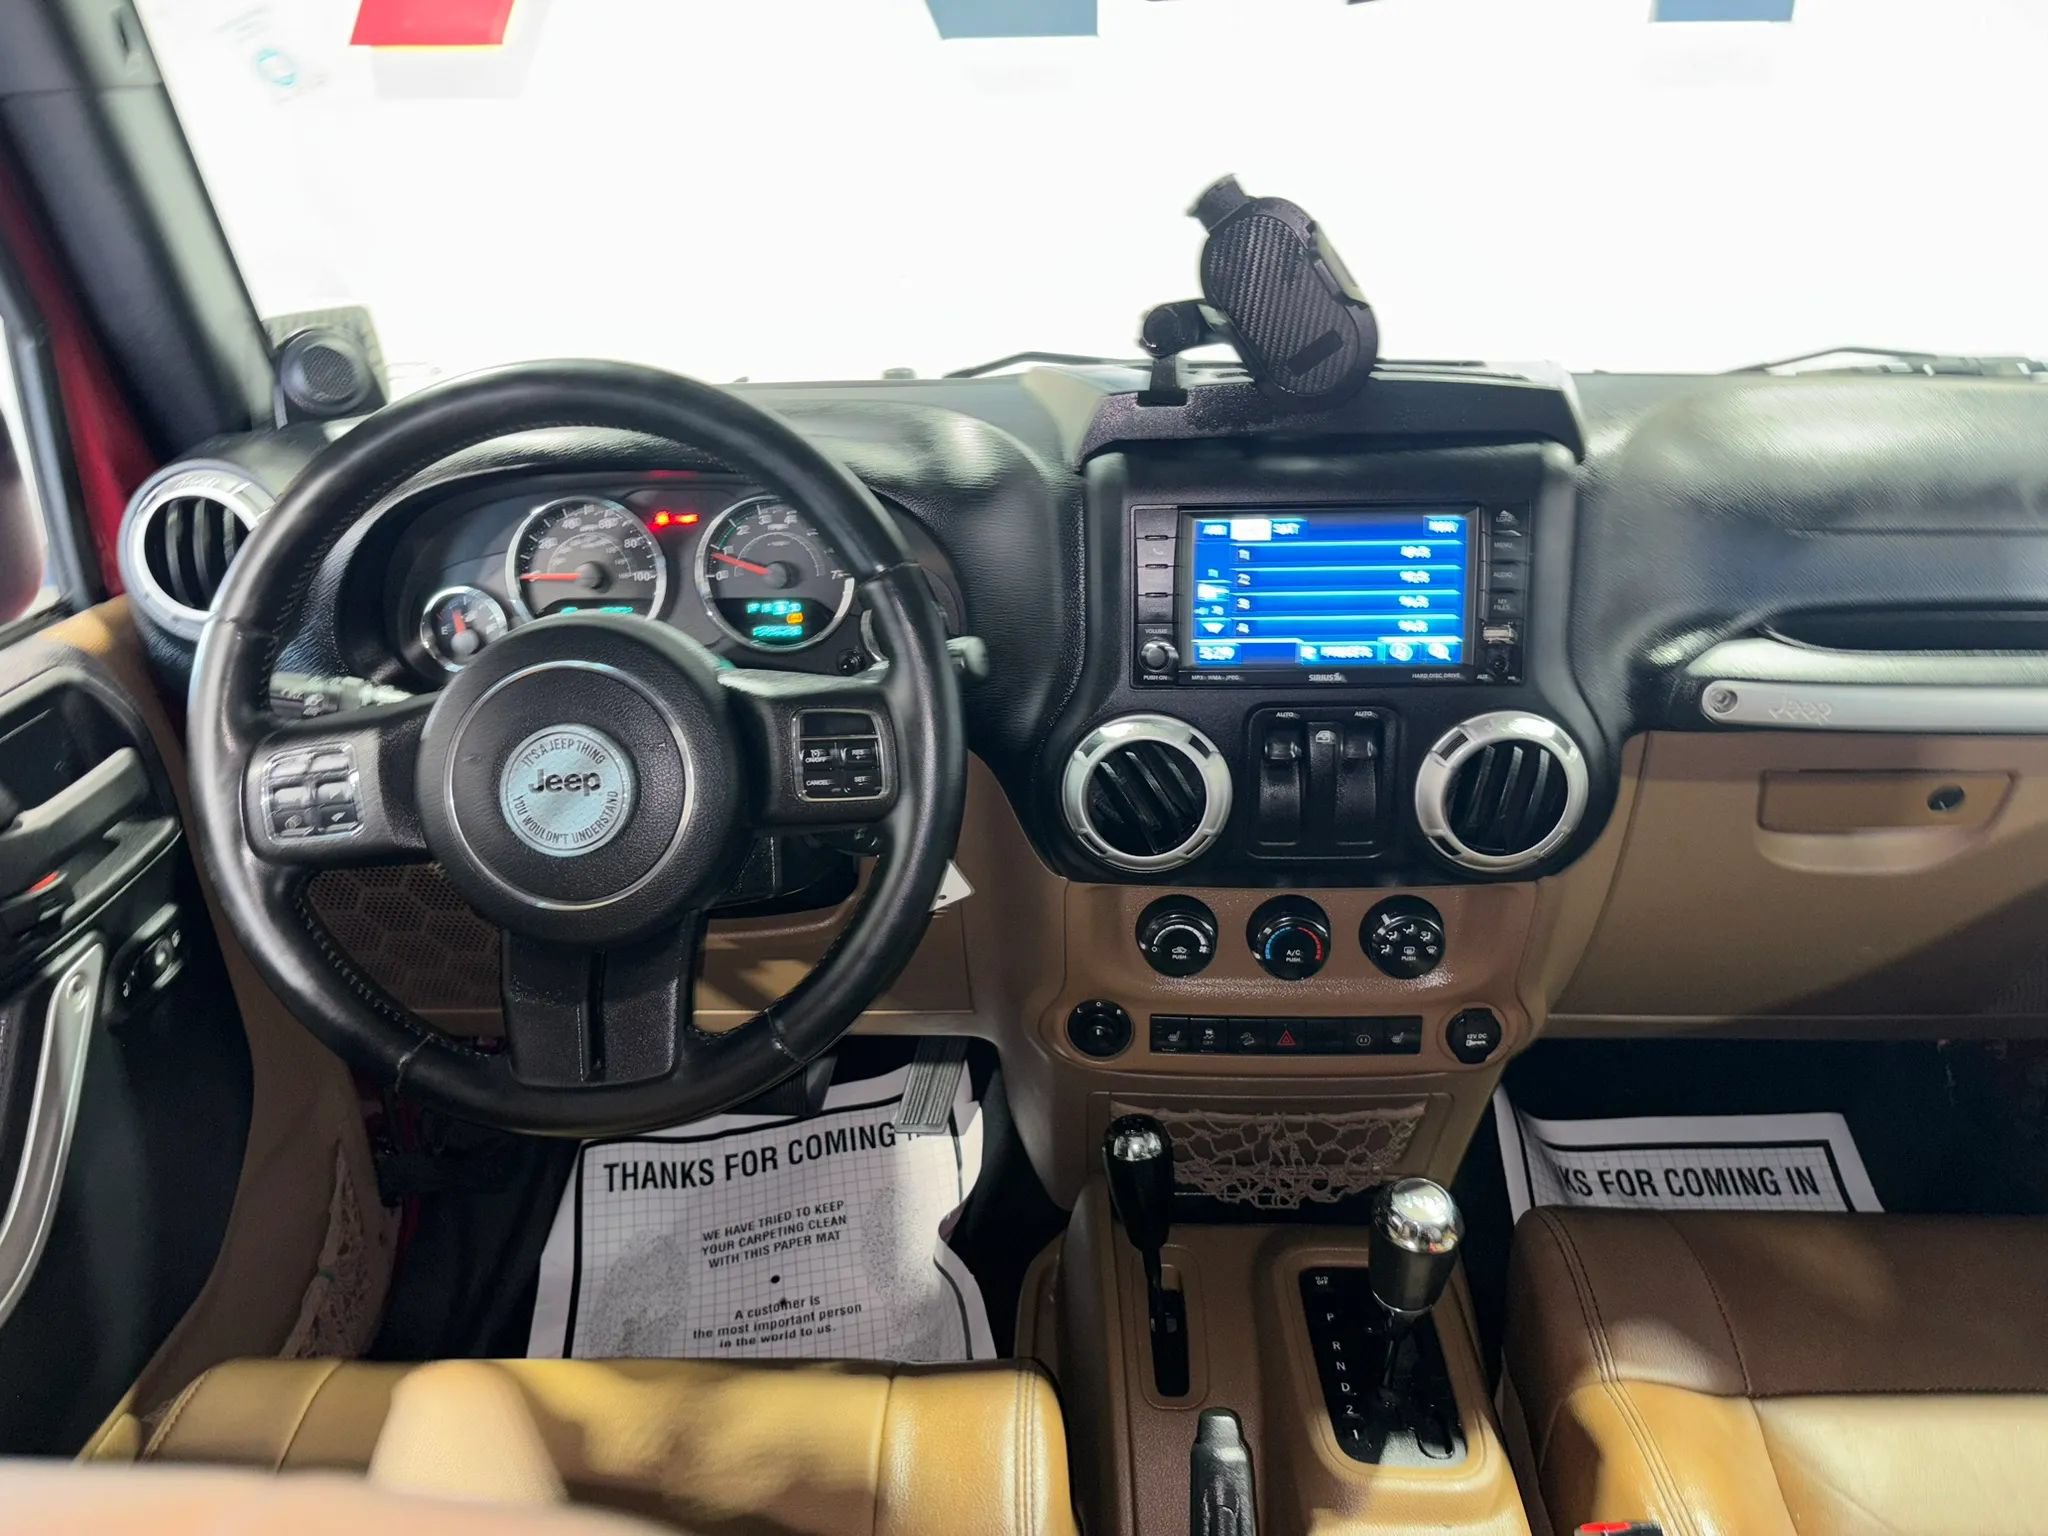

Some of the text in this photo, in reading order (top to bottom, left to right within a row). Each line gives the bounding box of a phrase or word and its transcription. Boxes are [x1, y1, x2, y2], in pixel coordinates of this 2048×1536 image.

[624, 538, 638, 548] 80
[736, 525, 749, 536] 2
[632, 571, 650, 582] 100
[549, 738, 575, 751] JEEP
[575, 739, 606, 765] THING
[528, 769, 601, 797] Jeep
[571, 790, 619, 844] UNDERSTAND
[603, 1121, 896, 1192] THANKS FOR COMING
[1598, 1168, 1660, 1197] FOR
[1664, 1167, 1779, 1197] COMING
[1785, 1166, 1821, 1197] IN
[702, 1200, 845, 1242] WE HAVE TRIED TO KEEP
[702, 1214, 847, 1256] YOUR CARPETING CLEAN
[708, 1230, 842, 1269] WITH THIS PAPER MAT
[734, 1295, 821, 1321] A customer is
[1326, 1312, 1335, 1321] P
[692, 1303, 862, 1340] the most important person
[719, 1339, 732, 1349] in
[736, 1336, 757, 1347] the
[760, 1328, 797, 1344] world
[800, 1326, 813, 1337] to
[1332, 1341, 1341, 1350] R
[1336, 1361, 1346, 1371] N
[1341, 1383, 1350, 1392] D
[1346, 1405, 1354, 1415] 2
